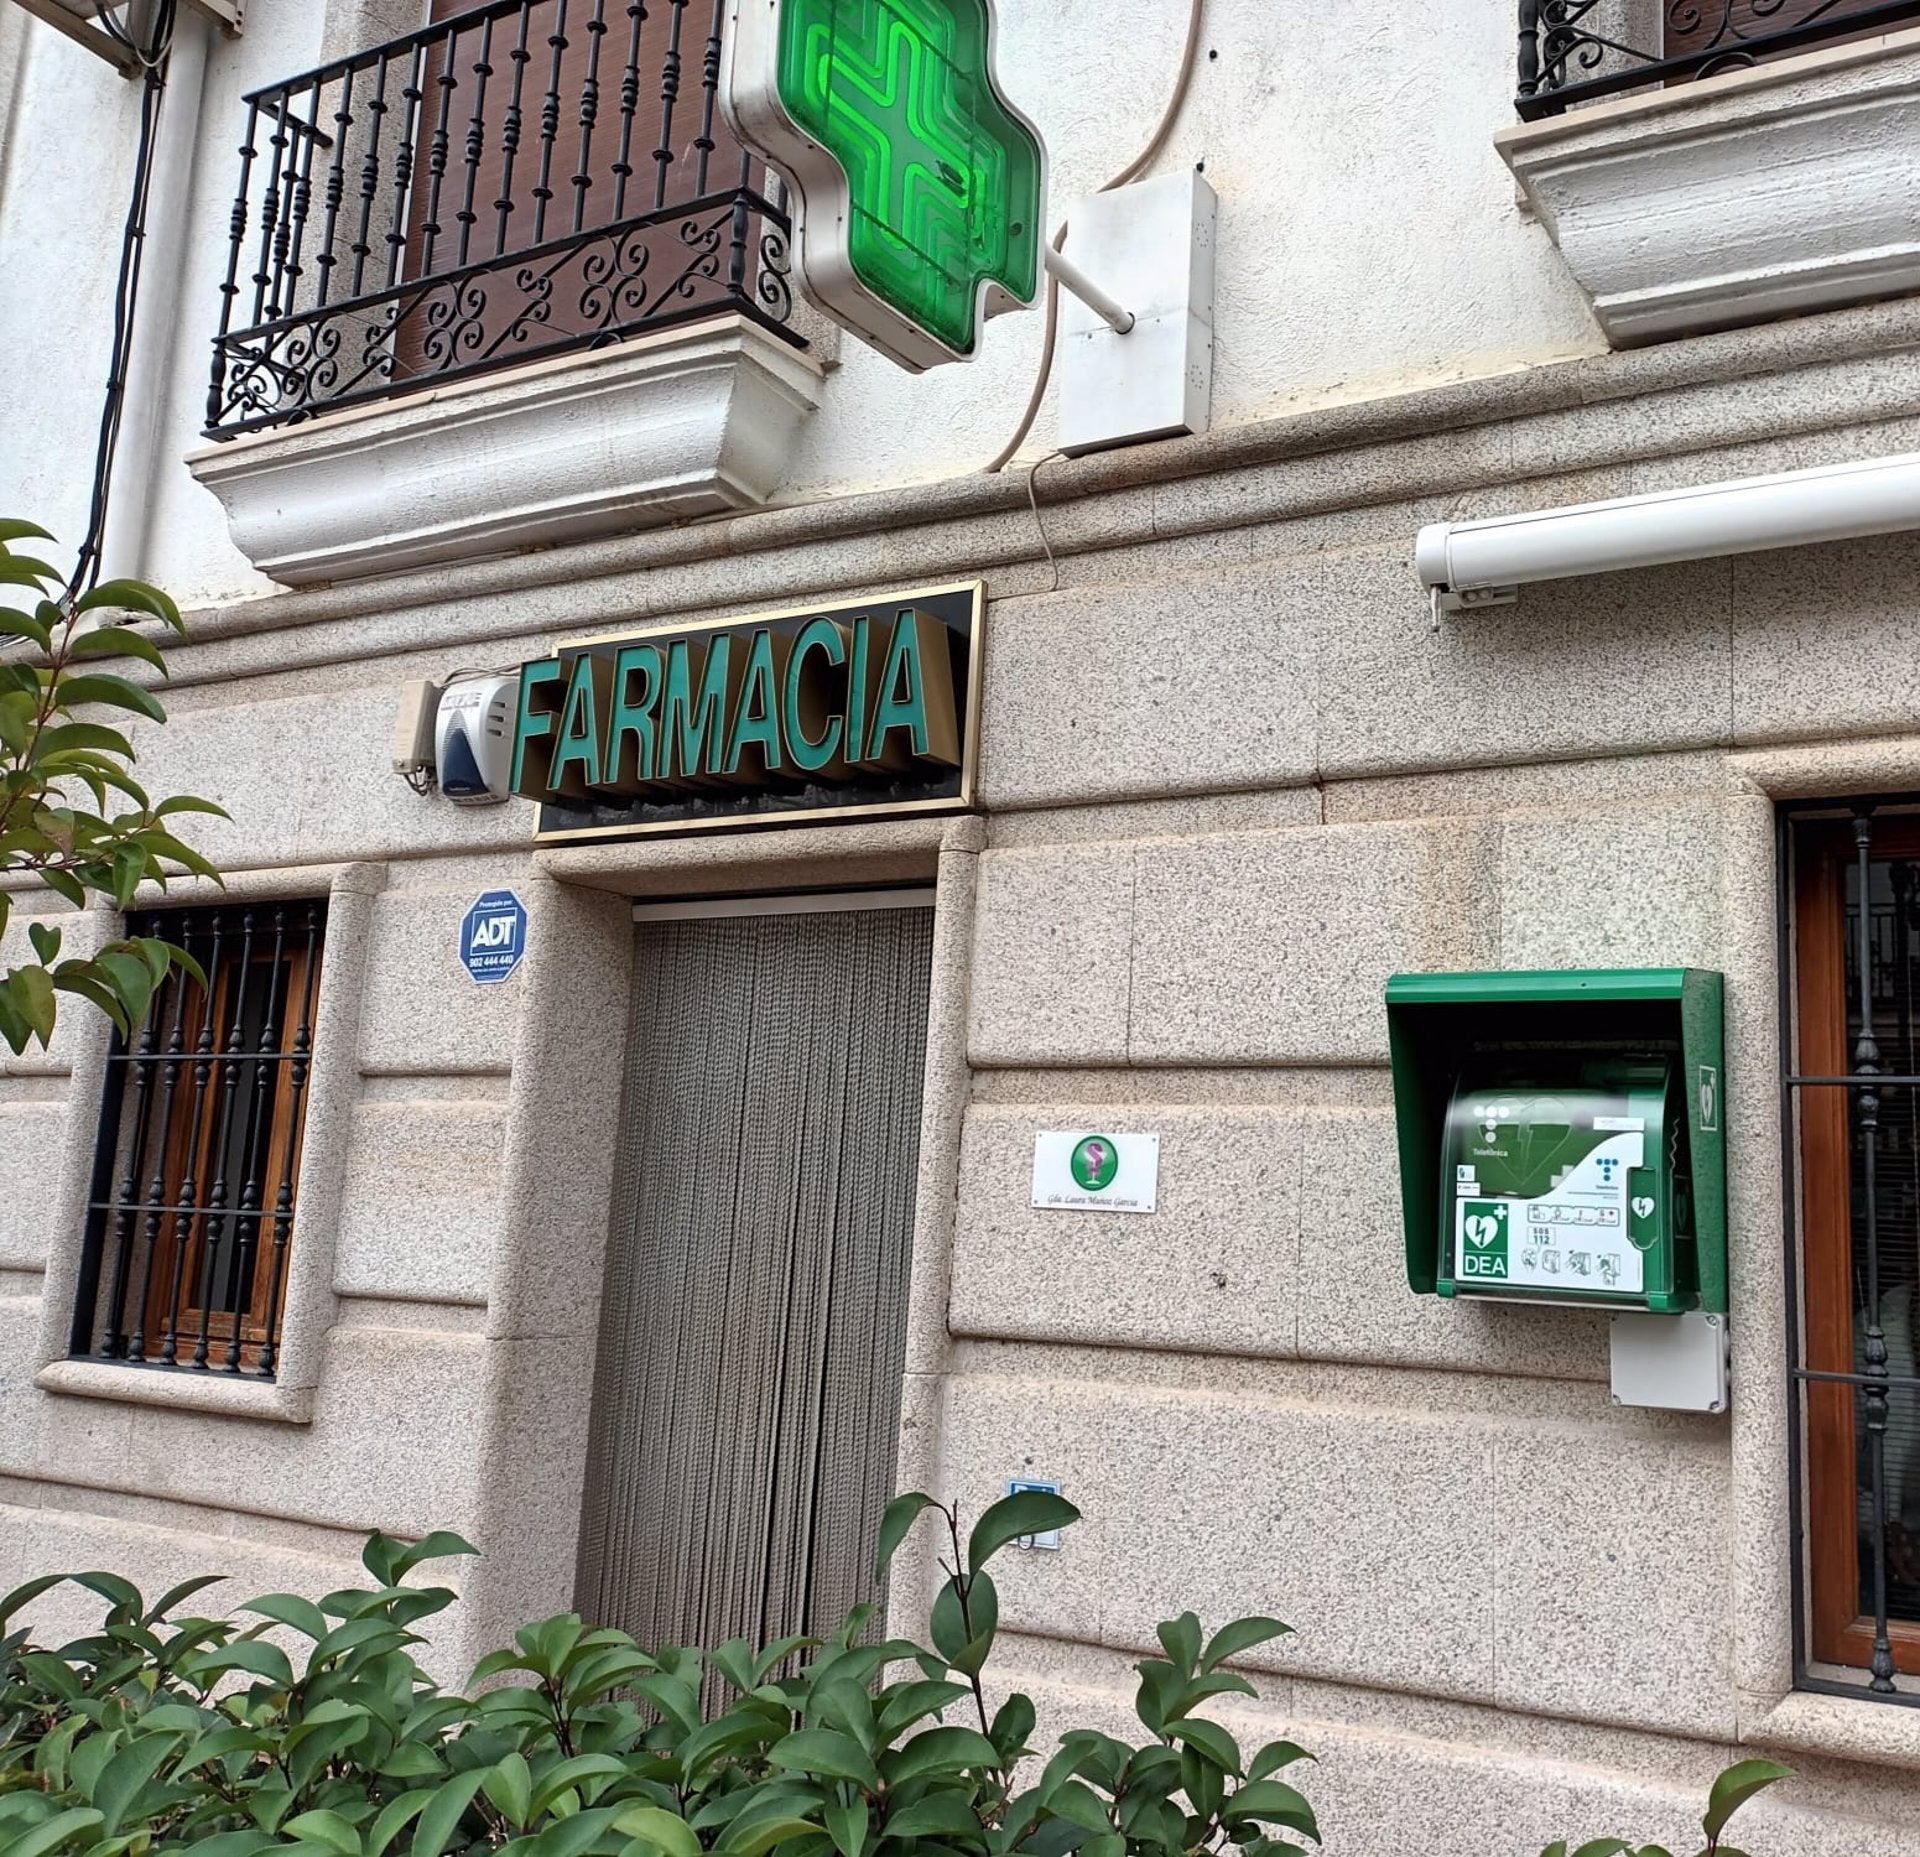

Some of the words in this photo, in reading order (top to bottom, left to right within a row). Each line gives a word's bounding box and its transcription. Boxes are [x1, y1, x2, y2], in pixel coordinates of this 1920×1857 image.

[509, 608, 932, 795] FARMACIA
[471, 916, 516, 948] ADT
[470, 957, 484, 968] 902
[484, 955, 499, 966] 444
[499, 954, 514, 965] 440
[1065, 1194, 1086, 1204] Laura
[1533, 1235, 1549, 1245] 112
[1464, 1256, 1506, 1275] DEA
